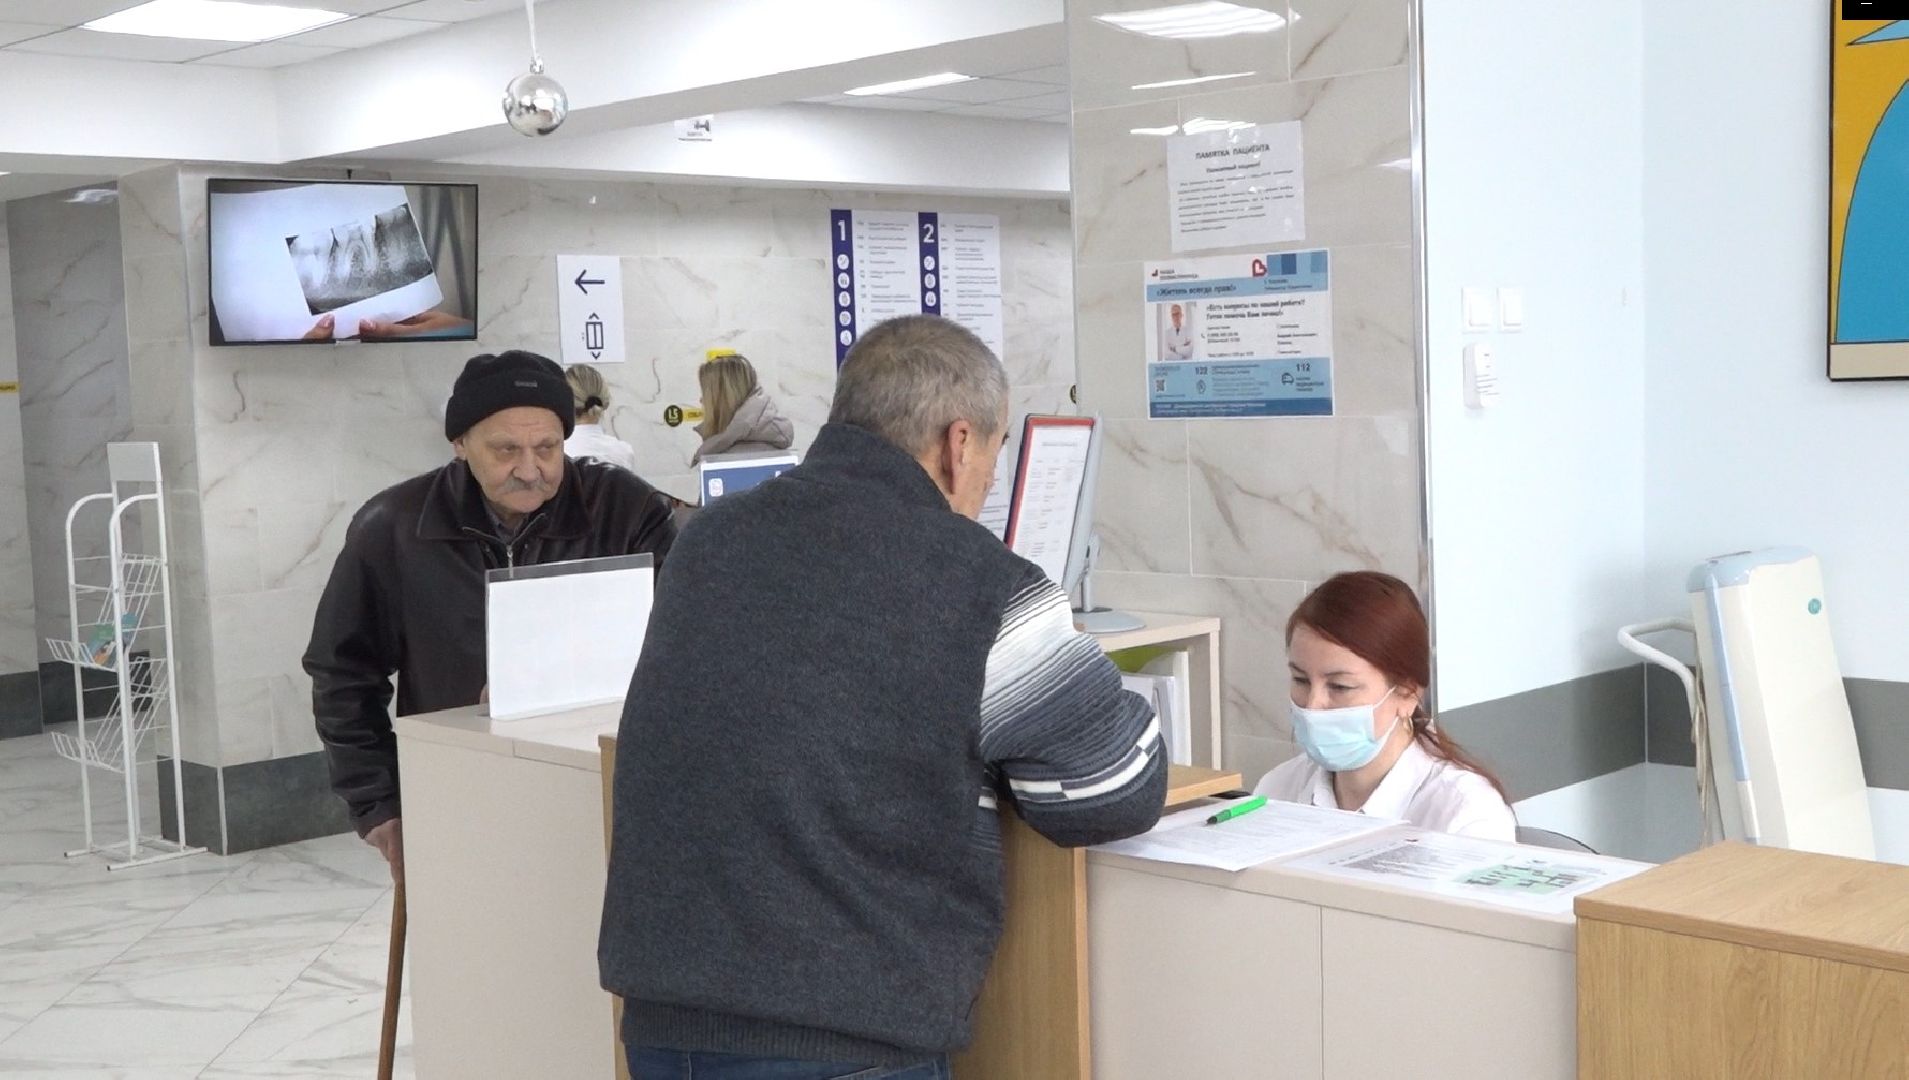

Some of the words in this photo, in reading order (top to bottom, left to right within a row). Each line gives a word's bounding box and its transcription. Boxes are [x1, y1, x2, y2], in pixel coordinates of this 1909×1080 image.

[1195, 149, 1230, 160] ПАМЯТКА
[1233, 144, 1270, 155] ПАЦИЕНТА
[838, 219, 846, 241] 1
[923, 223, 935, 243] 2
[1189, 286, 1212, 294] всегда
[1296, 363, 1310, 372] 112
